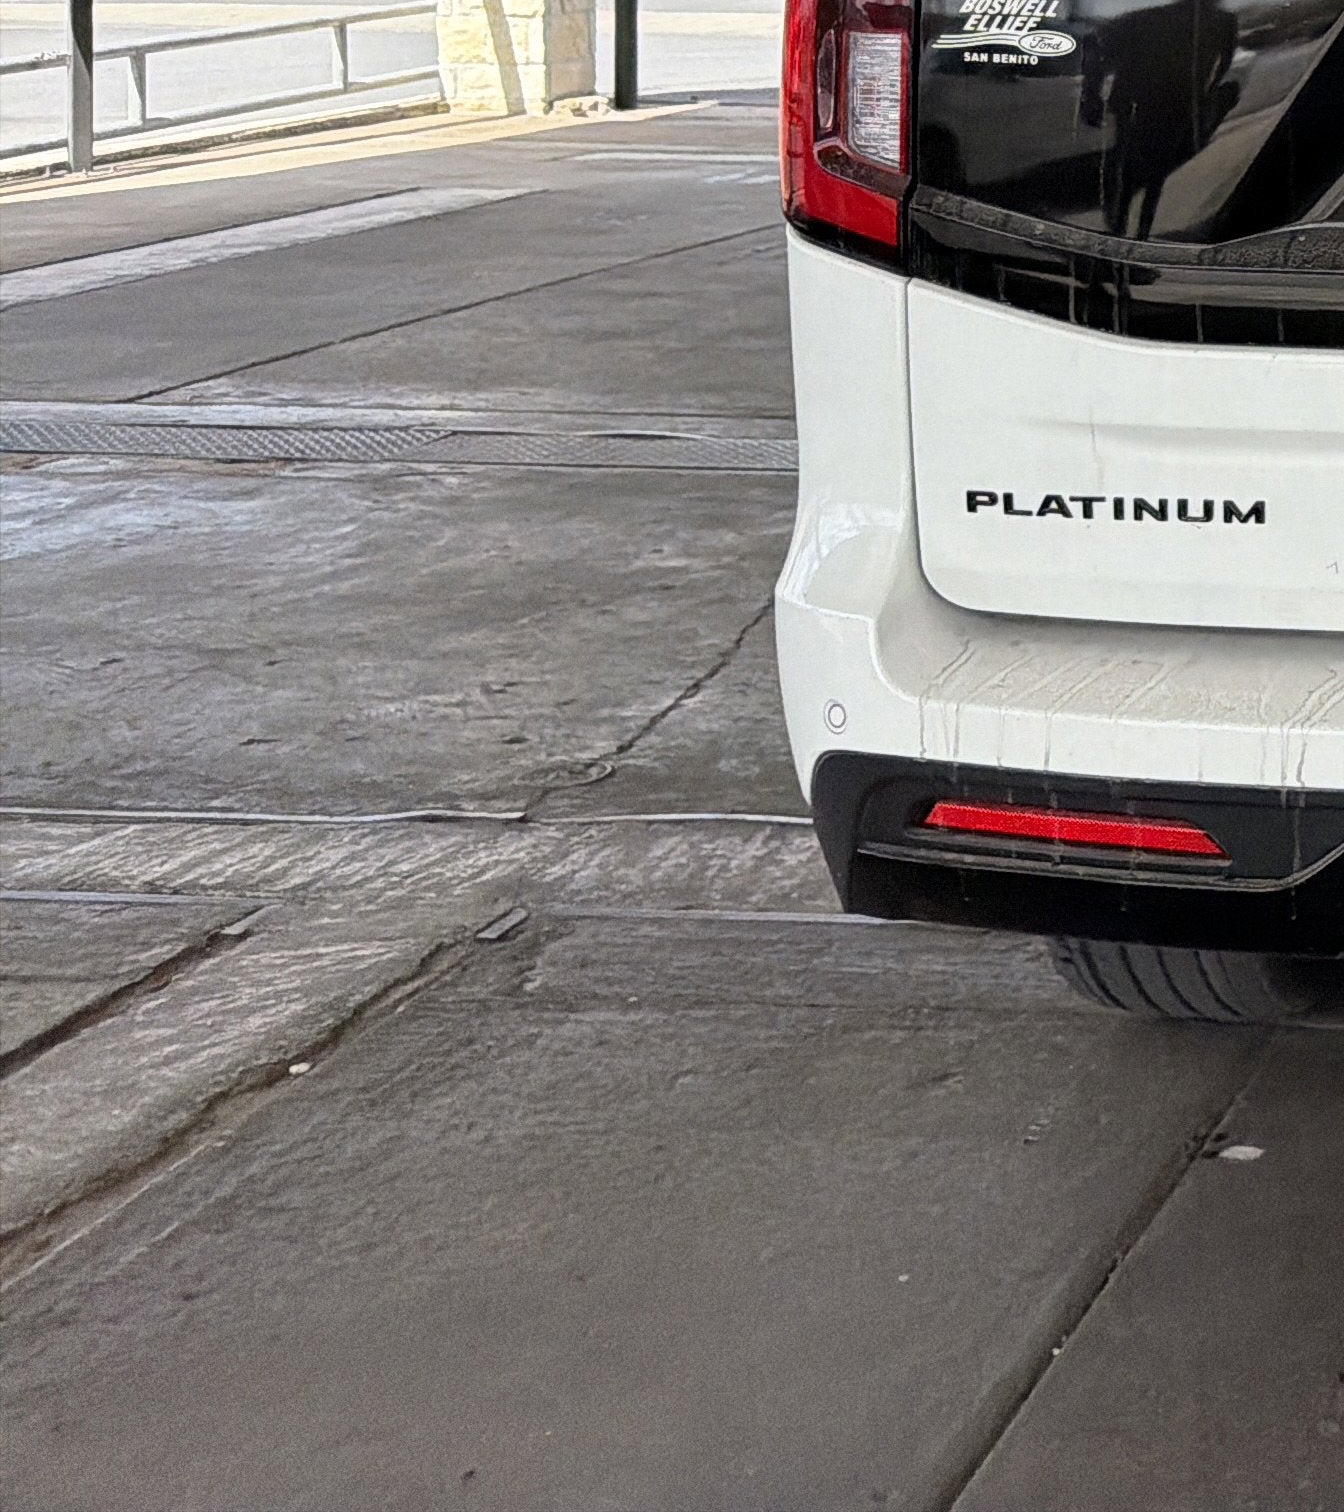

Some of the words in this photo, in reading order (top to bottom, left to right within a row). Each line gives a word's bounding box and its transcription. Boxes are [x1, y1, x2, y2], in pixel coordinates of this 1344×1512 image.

[962, 14, 1041, 32] ELLIFF
[1029, 35, 1063, 50] Ford
[963, 51, 988, 63] SAN
[992, 53, 1039, 65] BENITO
[966, 490, 1267, 525] PLATINUM
